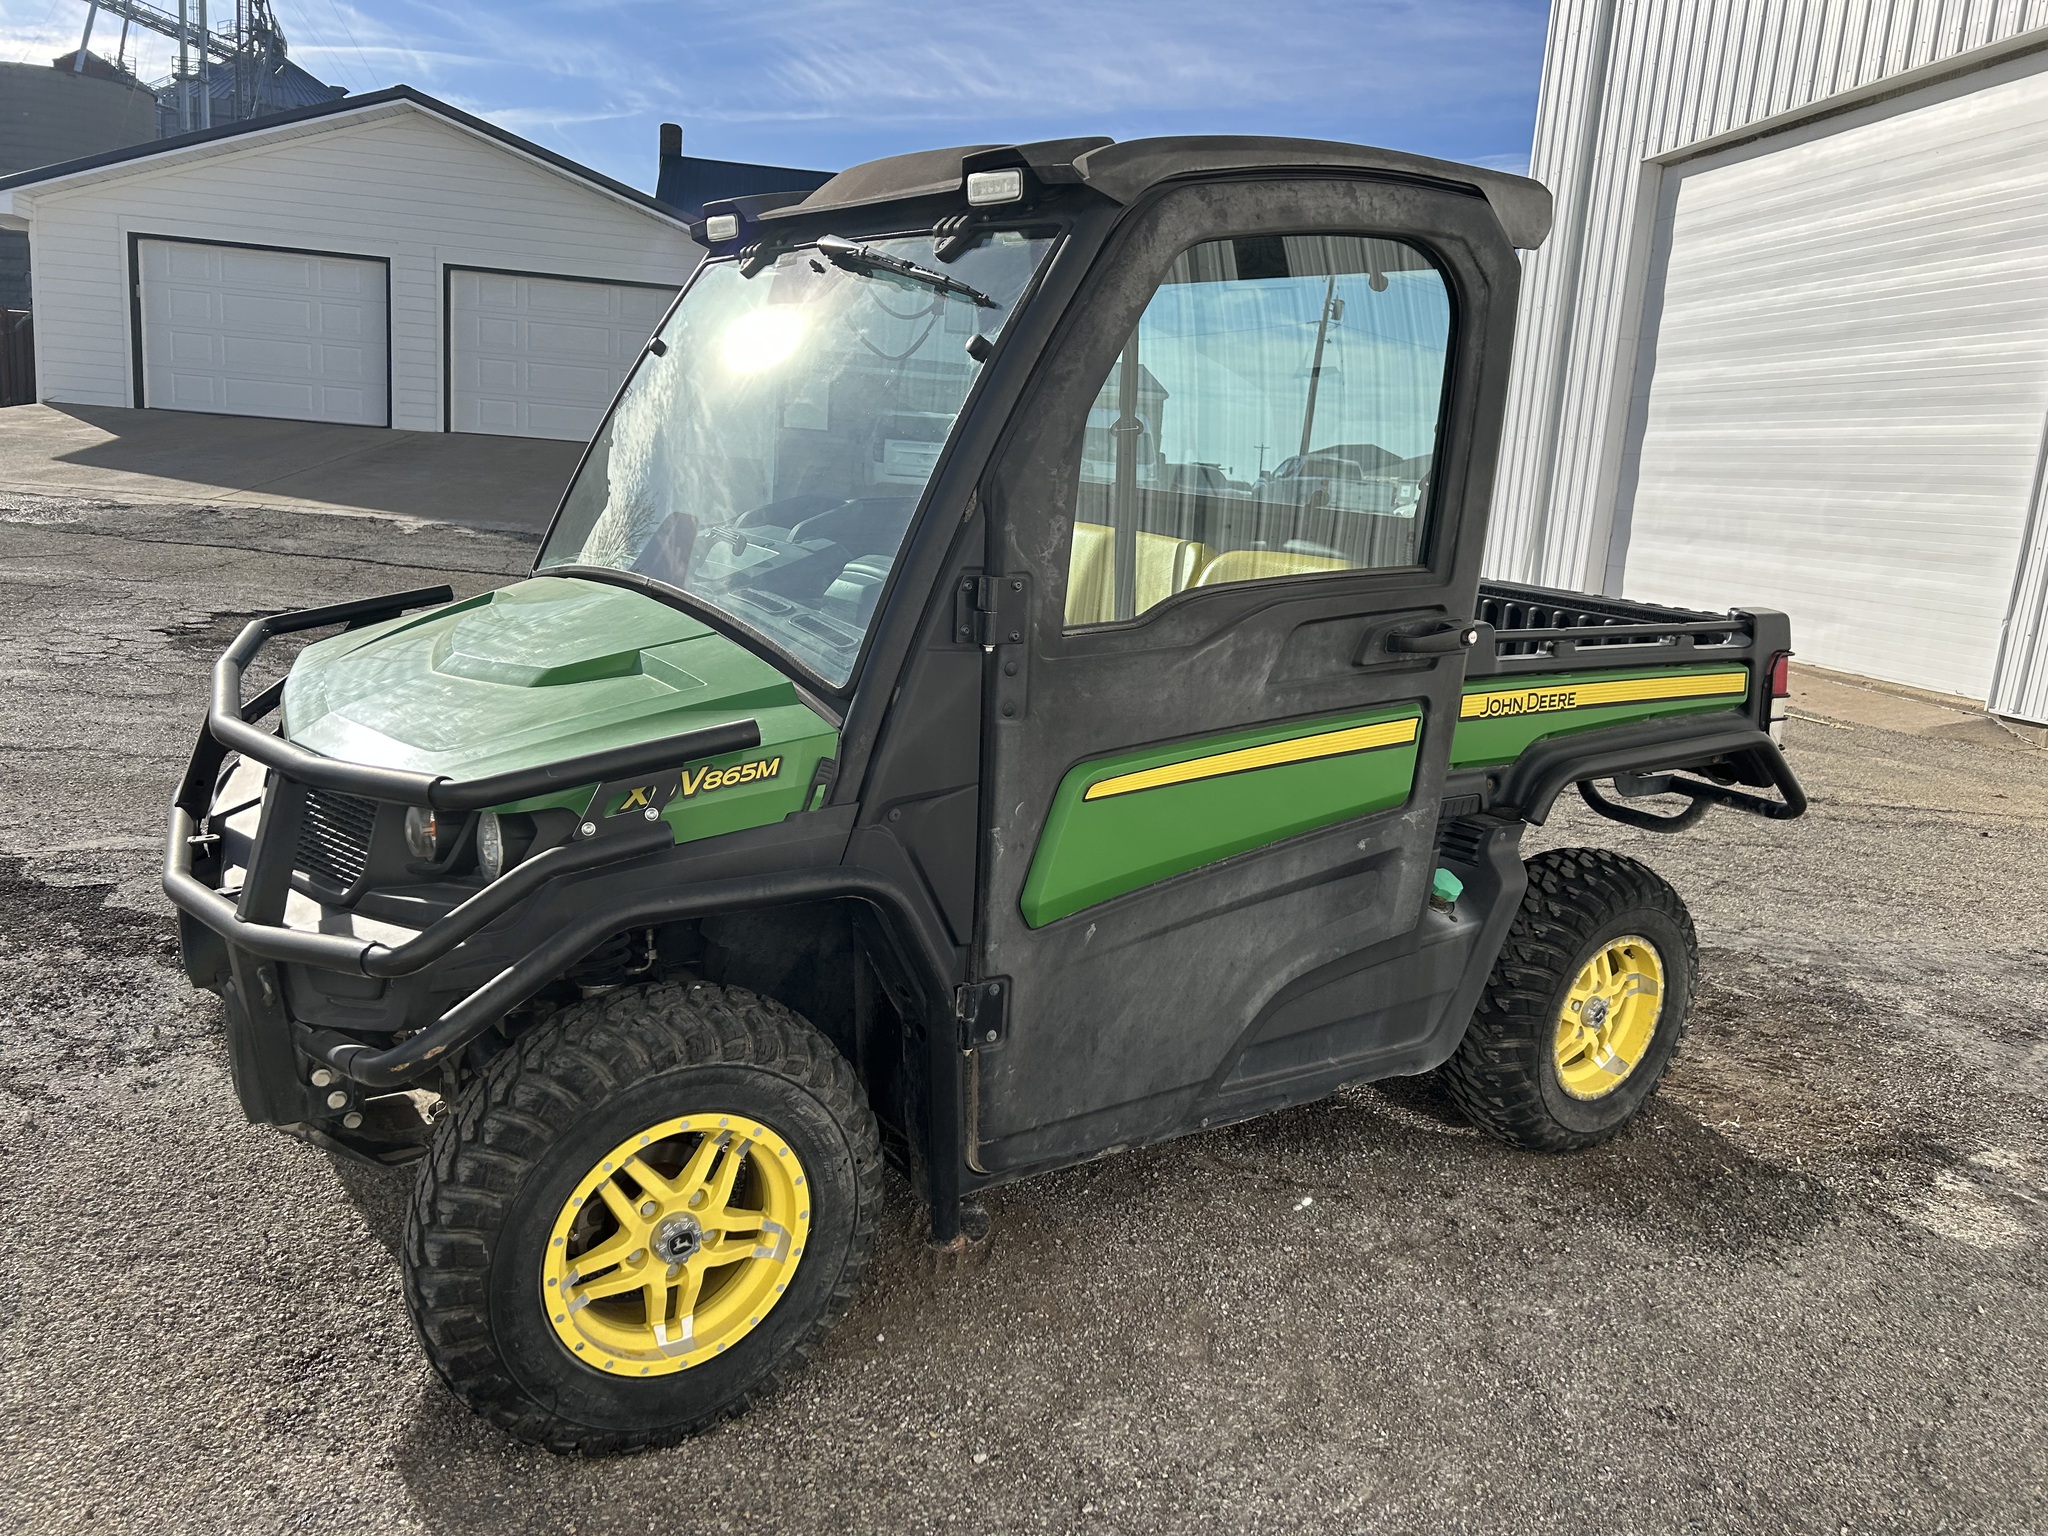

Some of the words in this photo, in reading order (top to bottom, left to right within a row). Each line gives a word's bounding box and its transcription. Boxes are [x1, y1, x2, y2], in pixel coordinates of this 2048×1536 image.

[1480, 696, 1524, 716] JOHN
[1527, 691, 1577, 711] DEERE
[619, 757, 781, 811] XV865M
